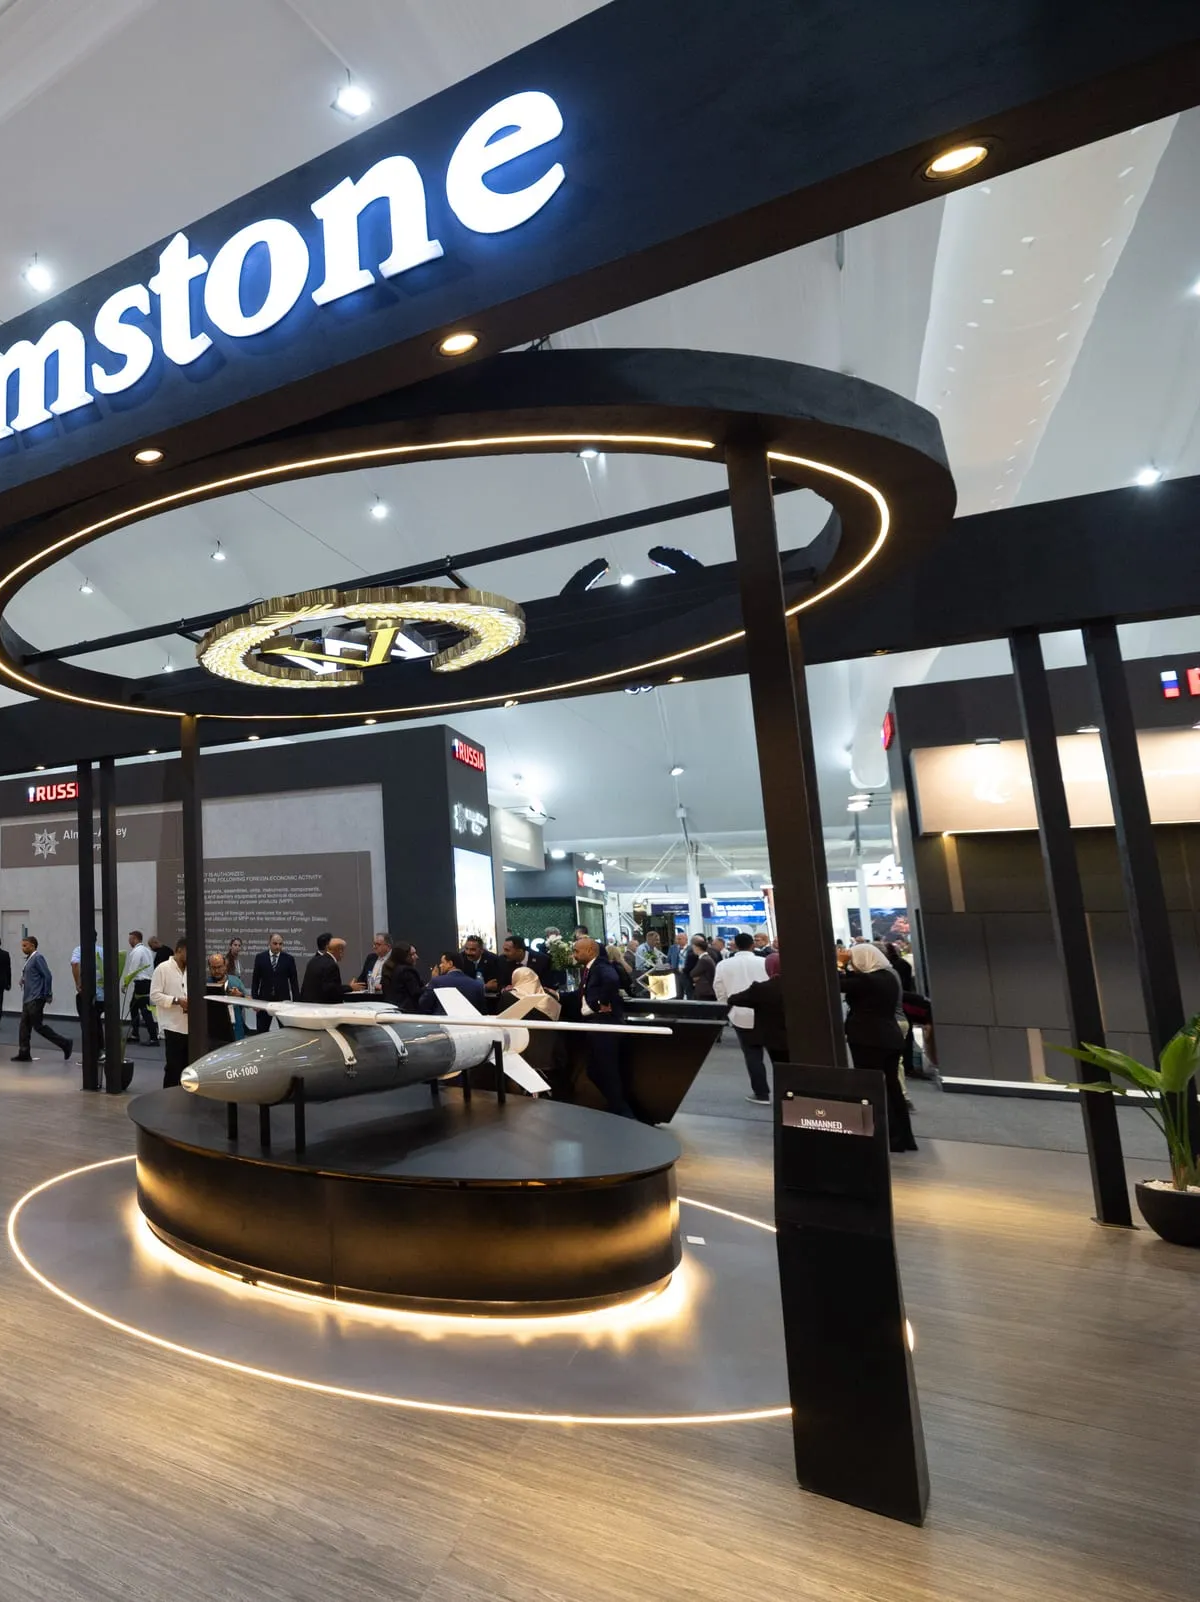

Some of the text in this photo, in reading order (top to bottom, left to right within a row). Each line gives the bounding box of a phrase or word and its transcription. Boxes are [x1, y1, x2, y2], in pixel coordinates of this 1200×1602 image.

[458, 740, 486, 772] RUSSIA
[36, 783, 79, 801] RUSSI
[225, 1065, 259, 1080] GK-1000
[801, 1118, 842, 1129] UNMANNED
